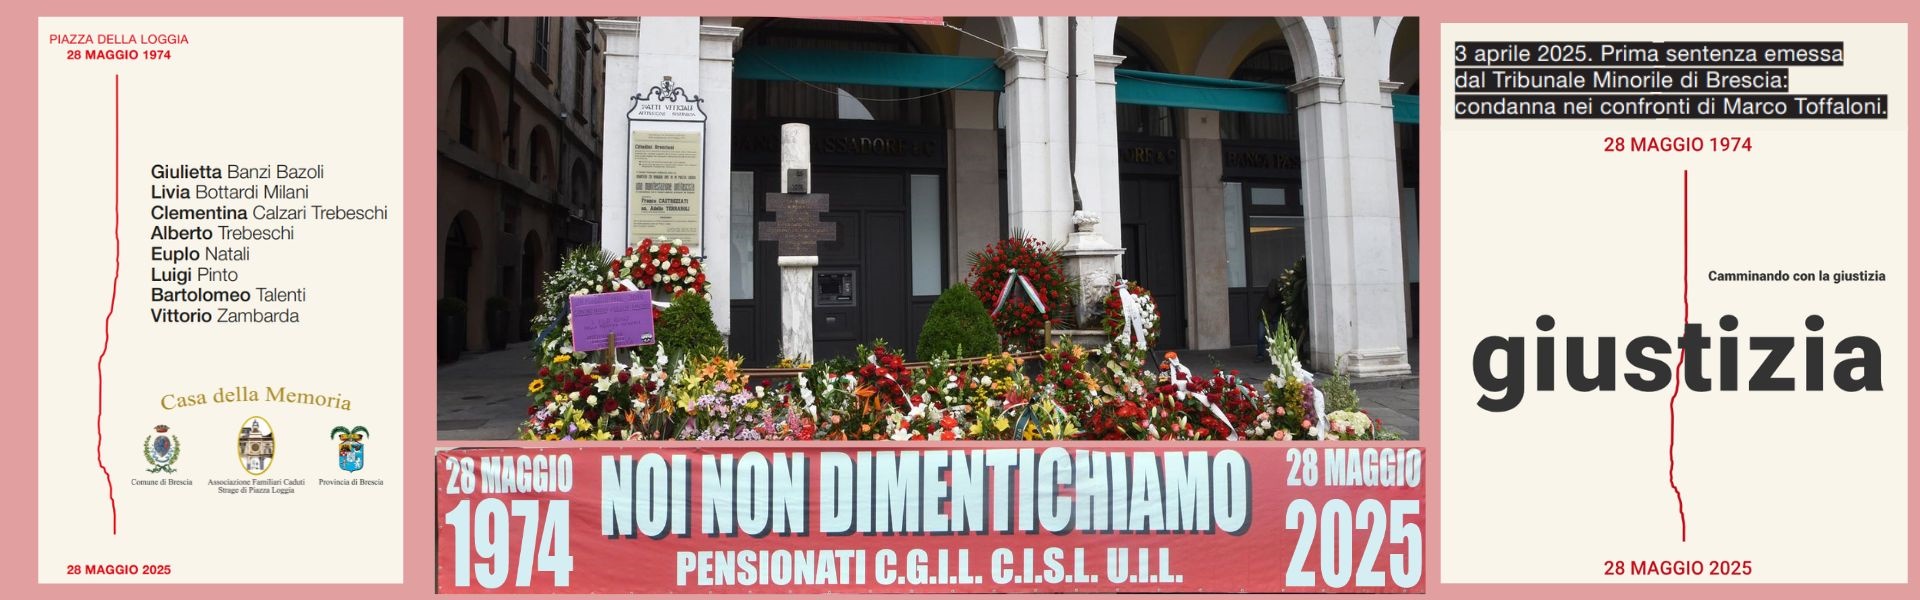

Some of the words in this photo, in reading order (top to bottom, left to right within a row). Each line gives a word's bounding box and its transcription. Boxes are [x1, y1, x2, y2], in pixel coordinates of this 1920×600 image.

[49, 33, 94, 45] PIAZZA
[97, 33, 138, 45] DELLA
[140, 33, 189, 45] LOGGIA
[66, 49, 82, 61] 28
[85, 49, 139, 61] MAGGIO
[142, 49, 172, 61] 1974
[1456, 44, 1467, 62] 3
[1475, 44, 1531, 66] aprile
[1538, 44, 1593, 62] 2025.
[1601, 44, 1659, 62] Prima
[1665, 45, 1758, 62] sentenza
[1764, 48, 1843, 62] emessa
[1455, 71, 1485, 89] dal
[1492, 71, 1586, 89] Tribunale
[1593, 71, 1673, 89] Minorile
[1680, 71, 1698, 89] di
[1706, 71, 1788, 89] Brescia:
[1455, 97, 1556, 115] condanna
[1563, 97, 1593, 115] nei
[1600, 97, 1690, 115] confronti
[1697, 97, 1715, 115] di
[1723, 97, 1787, 115] Marco
[1794, 97, 1887, 115] Toffaloni.
[1603, 136, 1626, 153] 28
[1630, 136, 1704, 153] MAGGIO
[1710, 136, 1753, 153] 1974
[151, 164, 223, 180] Giulietta
[227, 164, 271, 180] Banzi
[276, 164, 324, 180] Bazoli
[151, 184, 191, 200] Livia
[195, 184, 259, 200] Bottardi
[263, 184, 309, 200] Milani
[150, 204, 248, 221] Clementina
[252, 204, 307, 221] Calzari
[311, 204, 388, 221] Trebeschi
[150, 225, 214, 241] Alberto
[218, 225, 294, 241] Trebeschi
[151, 245, 201, 265] Euplo
[205, 246, 250, 262] Natali
[151, 266, 192, 286] Luigi
[197, 266, 239, 282] Pinto
[1707, 269, 1790, 282] Camminando
[1793, 272, 1816, 282] con
[1818, 269, 1830, 282] la
[1832, 269, 1886, 285] giustizia
[151, 287, 252, 303] Bartolomeo
[256, 287, 306, 303] Talenti
[151, 307, 213, 324] Vittorio
[217, 307, 300, 324] Zambarda
[1472, 314, 1884, 413] giustizia
[160, 393, 208, 411] Casa
[212, 387, 260, 404] della
[265, 386, 353, 412] Memoria
[446, 455, 476, 495] 28
[481, 454, 573, 494] MAGGIO
[1285, 448, 1319, 487] 28
[1325, 448, 1422, 488] MAGGIO
[131, 478, 159, 487] Comune
[159, 478, 168, 487] di
[168, 478, 193, 487] Brescia
[207, 478, 252, 487] Associazione
[252, 478, 283, 487] Familiari
[283, 478, 306, 487] Caduti
[218, 486, 240, 495] Strage
[240, 486, 249, 494] di
[248, 486, 271, 494] Piazza
[271, 486, 295, 495] Loggia
[319, 478, 351, 487] Provincia
[351, 478, 359, 487] di
[359, 478, 384, 487] Brescia
[600, 453, 687, 537] NOI
[701, 452, 805, 536] NON
[819, 446, 1251, 535] DIMENTICHIAMO
[445, 497, 574, 589] 1974
[1285, 498, 1423, 589] 2025
[66, 564, 82, 576] 28
[84, 564, 139, 576] MAGGIO
[142, 564, 172, 576] 2025
[676, 549, 866, 586] PENSIONATI
[874, 547, 983, 586] C.G.I.L.
[991, 547, 1099, 585] C.I.S.L.
[1107, 547, 1184, 583] U.I.L.
[1603, 560, 1626, 576] 28
[1630, 560, 1704, 576] MAGGIO
[1709, 560, 1753, 576] 2025
